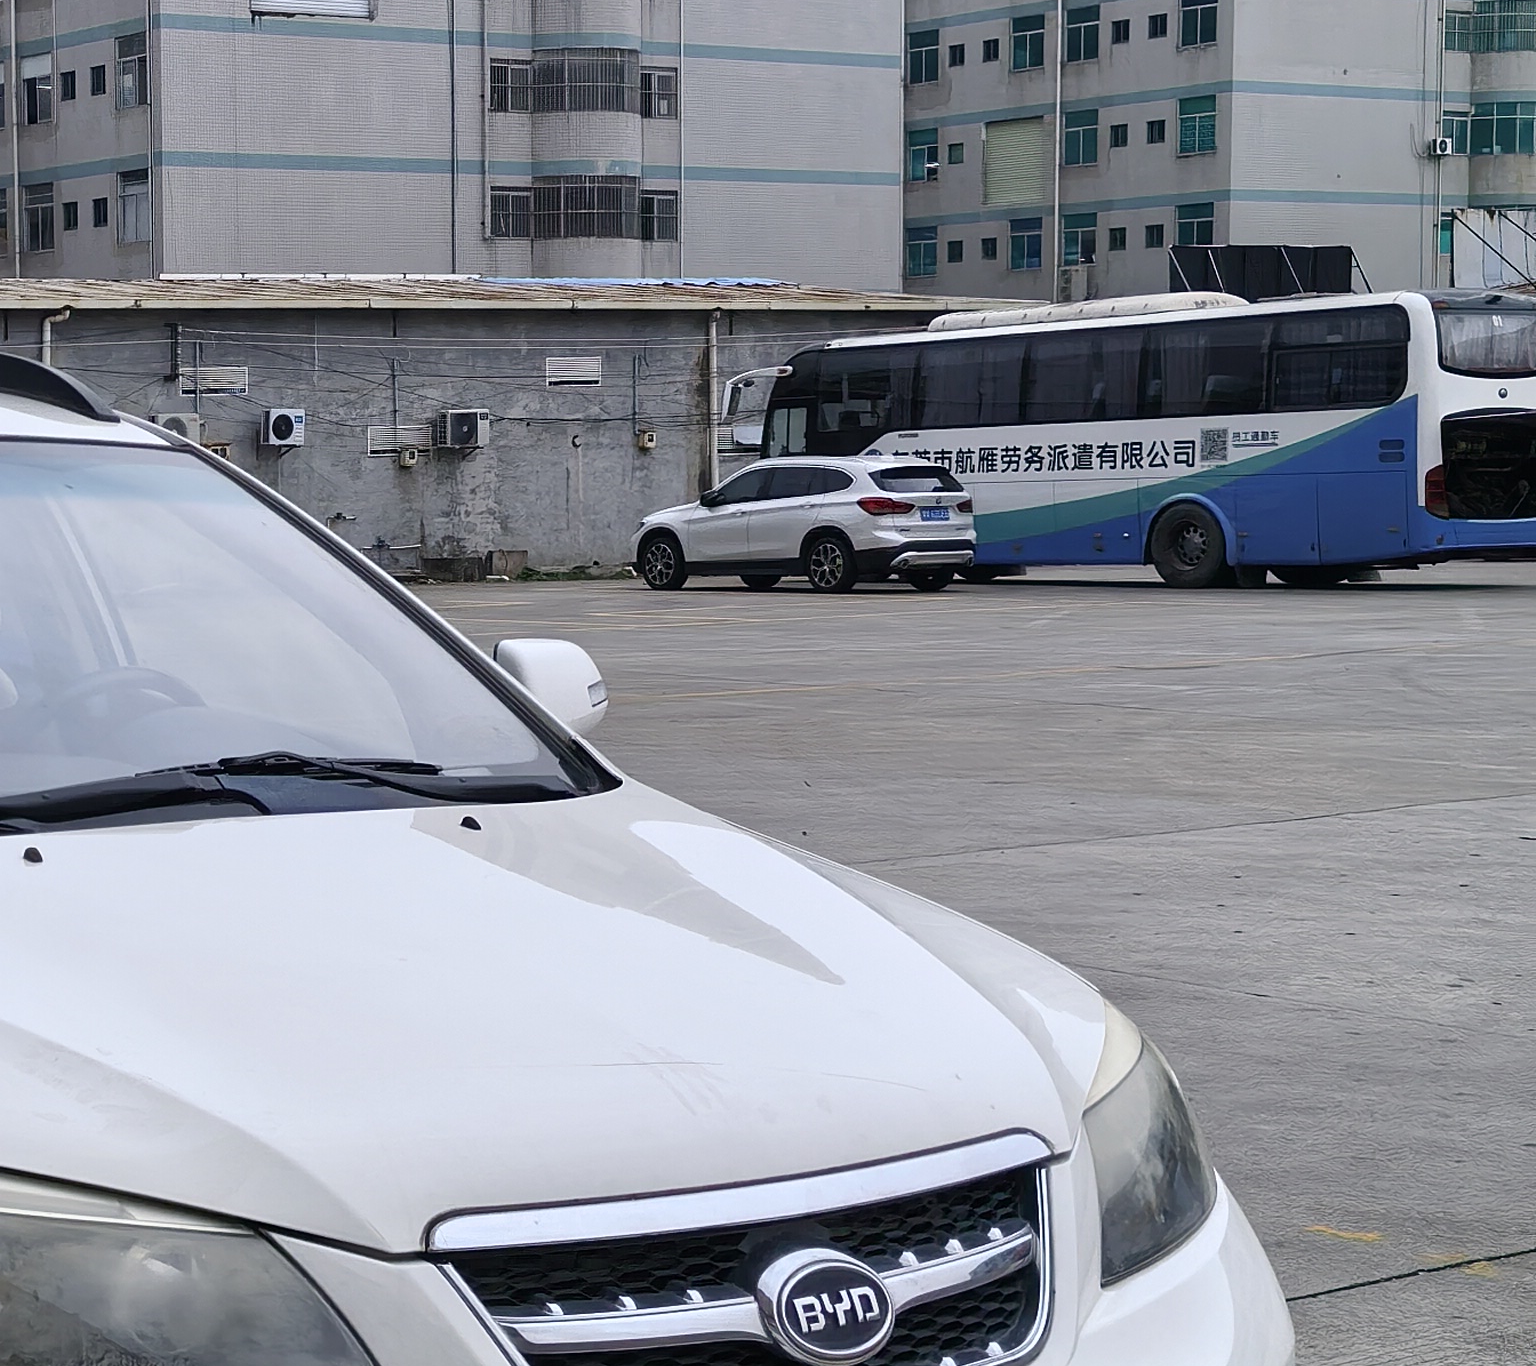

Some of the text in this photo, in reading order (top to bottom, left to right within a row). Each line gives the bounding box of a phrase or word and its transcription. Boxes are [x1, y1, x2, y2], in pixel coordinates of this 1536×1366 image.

[892, 439, 1196, 475] 市航雁劳务派遣有限公司
[792, 1285, 881, 1334] BYD
